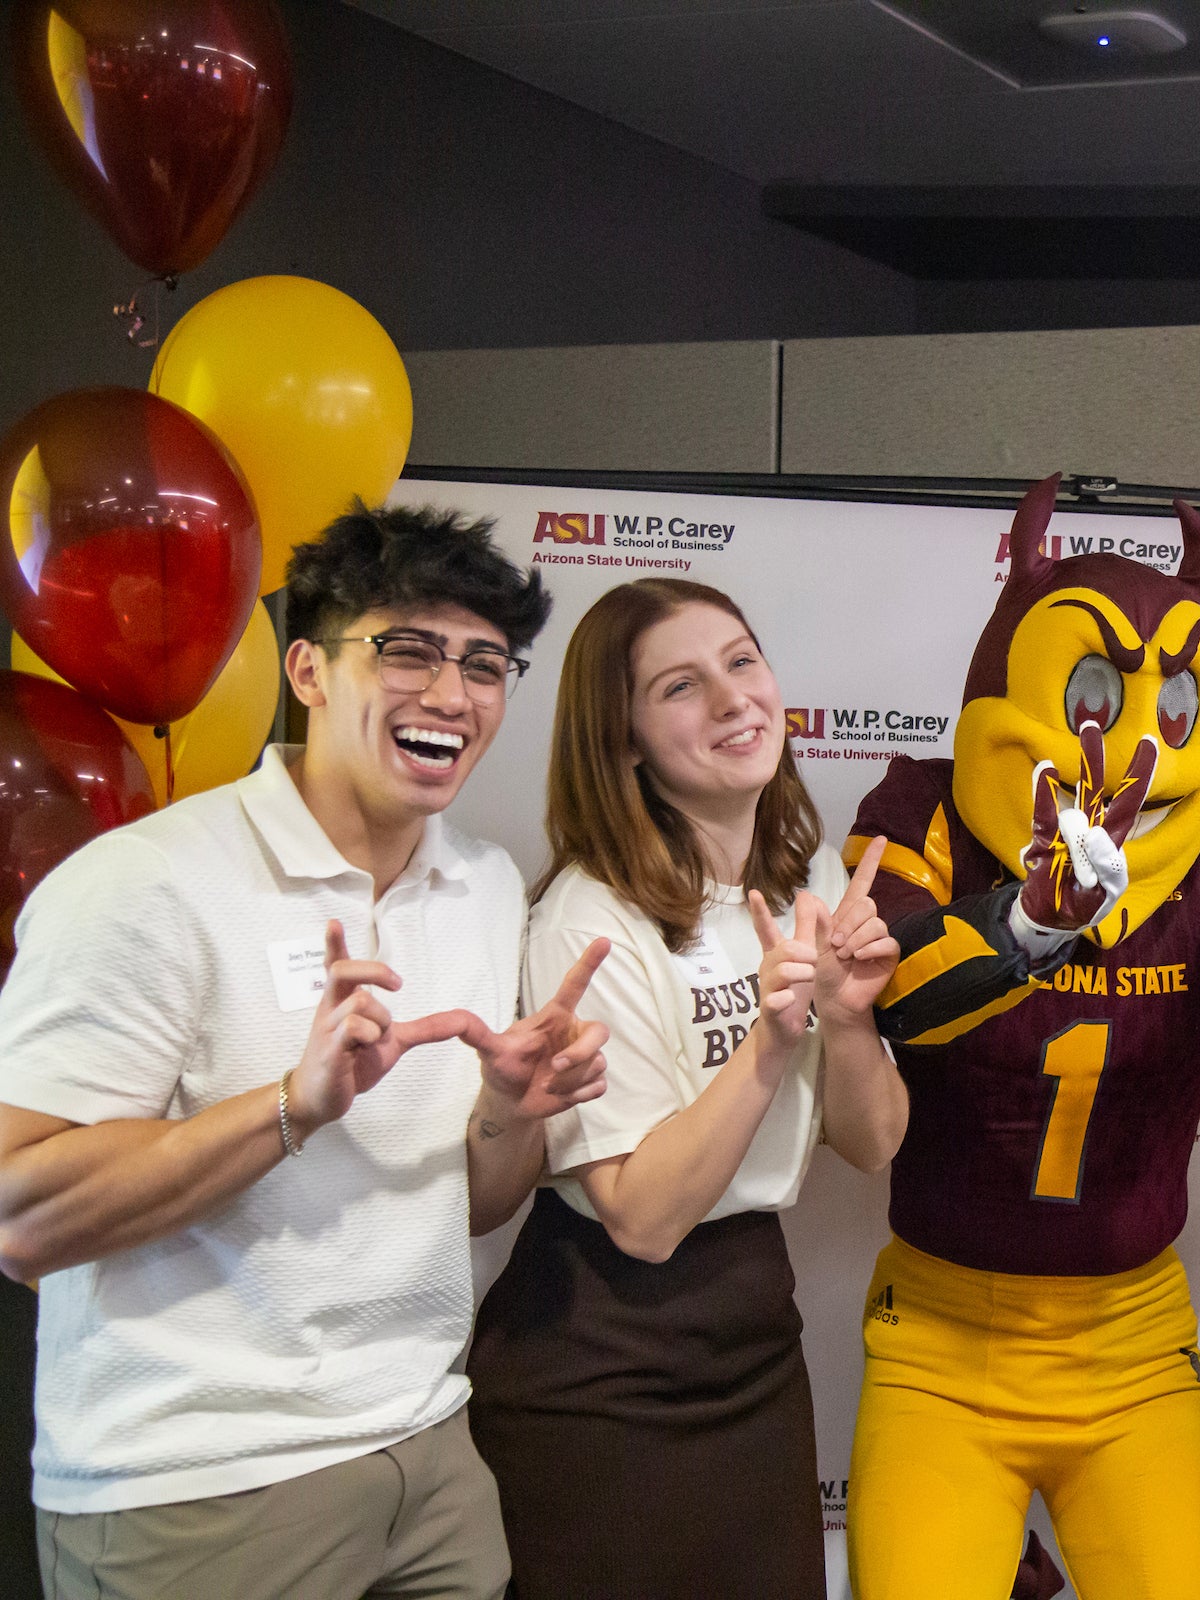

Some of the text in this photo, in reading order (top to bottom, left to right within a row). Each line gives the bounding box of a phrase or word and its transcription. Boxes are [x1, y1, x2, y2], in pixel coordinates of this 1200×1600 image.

[532, 511, 606, 545] ASU
[613, 515, 735, 543] W. P. Carey
[613, 537, 724, 551] School of Business
[994, 533, 1062, 563] AU
[1099, 538, 1115, 554] P
[1119, 539, 1181, 563] Carey
[532, 552, 692, 571] Arizona State University
[784, 708, 826, 740] SU
[832, 709, 949, 735] W. P. Carey
[832, 730, 938, 743] School of Business
[807, 748, 840, 759] State
[1115, 963, 1189, 997] STATE
[1031, 1019, 1111, 1203] 1
